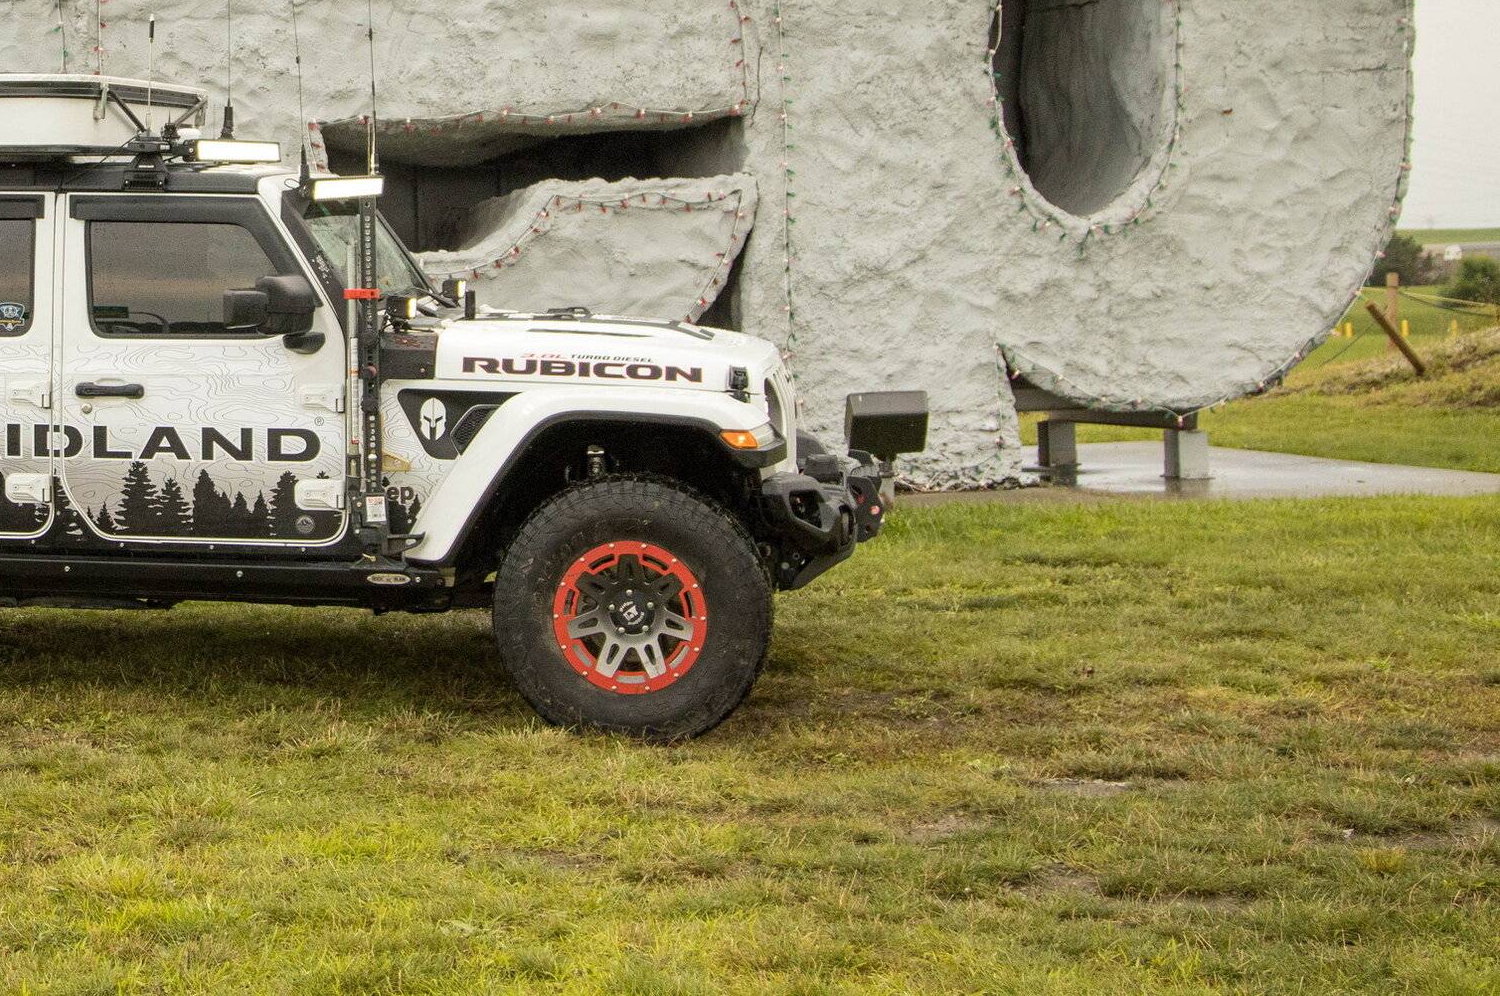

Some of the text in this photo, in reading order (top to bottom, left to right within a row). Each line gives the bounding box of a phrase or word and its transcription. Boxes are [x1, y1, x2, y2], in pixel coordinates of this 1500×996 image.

[571, 353, 611, 361] TURBO
[613, 355, 653, 363] DIESEL
[462, 356, 703, 383] RUBICON
